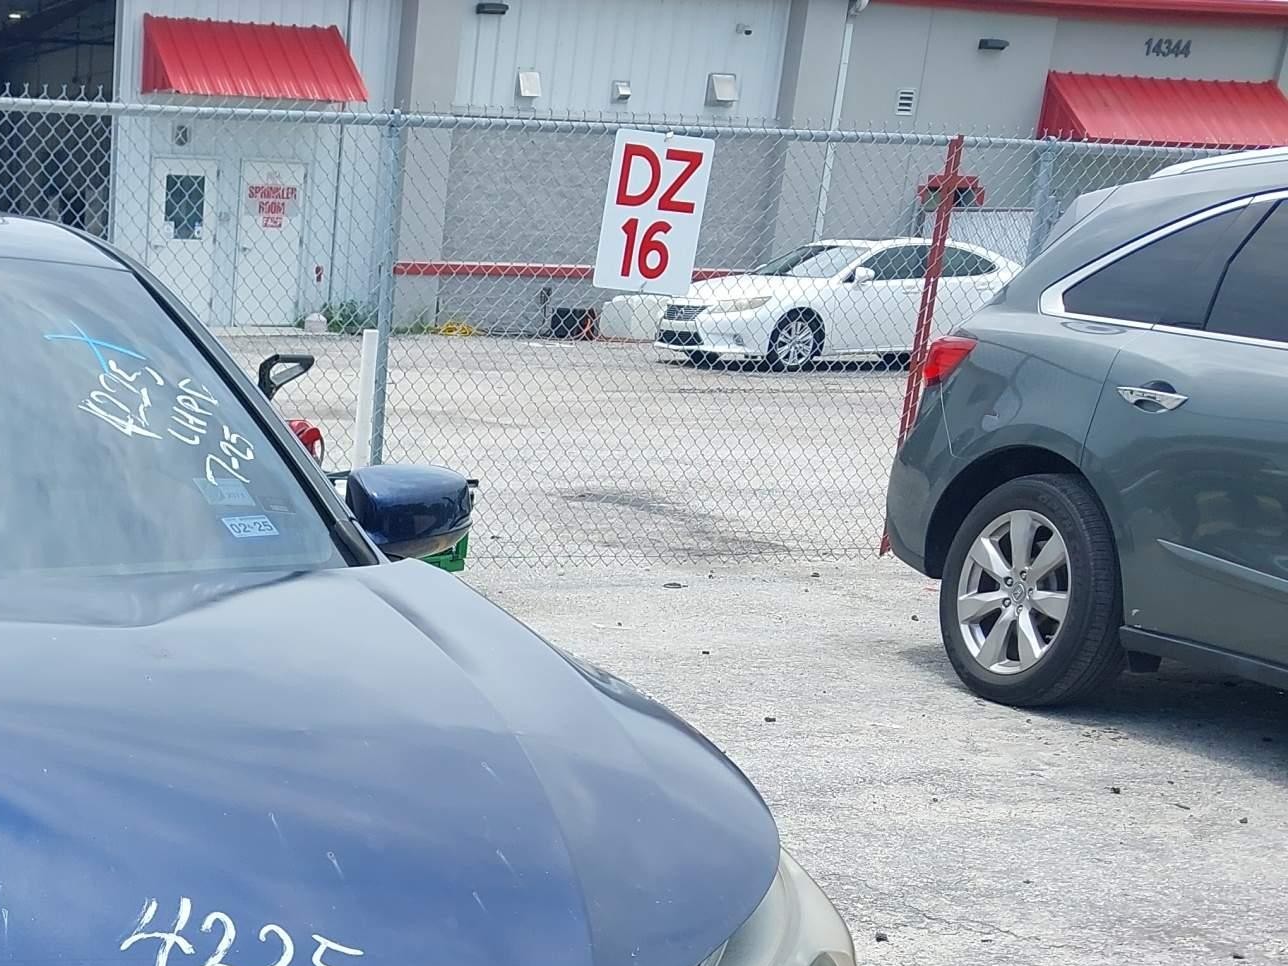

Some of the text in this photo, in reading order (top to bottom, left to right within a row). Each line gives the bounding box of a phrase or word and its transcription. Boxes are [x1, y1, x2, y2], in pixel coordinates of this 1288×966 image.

[1144, 38, 1192, 58] 14344
[615, 143, 704, 214] DZ
[620, 217, 673, 280] 16
